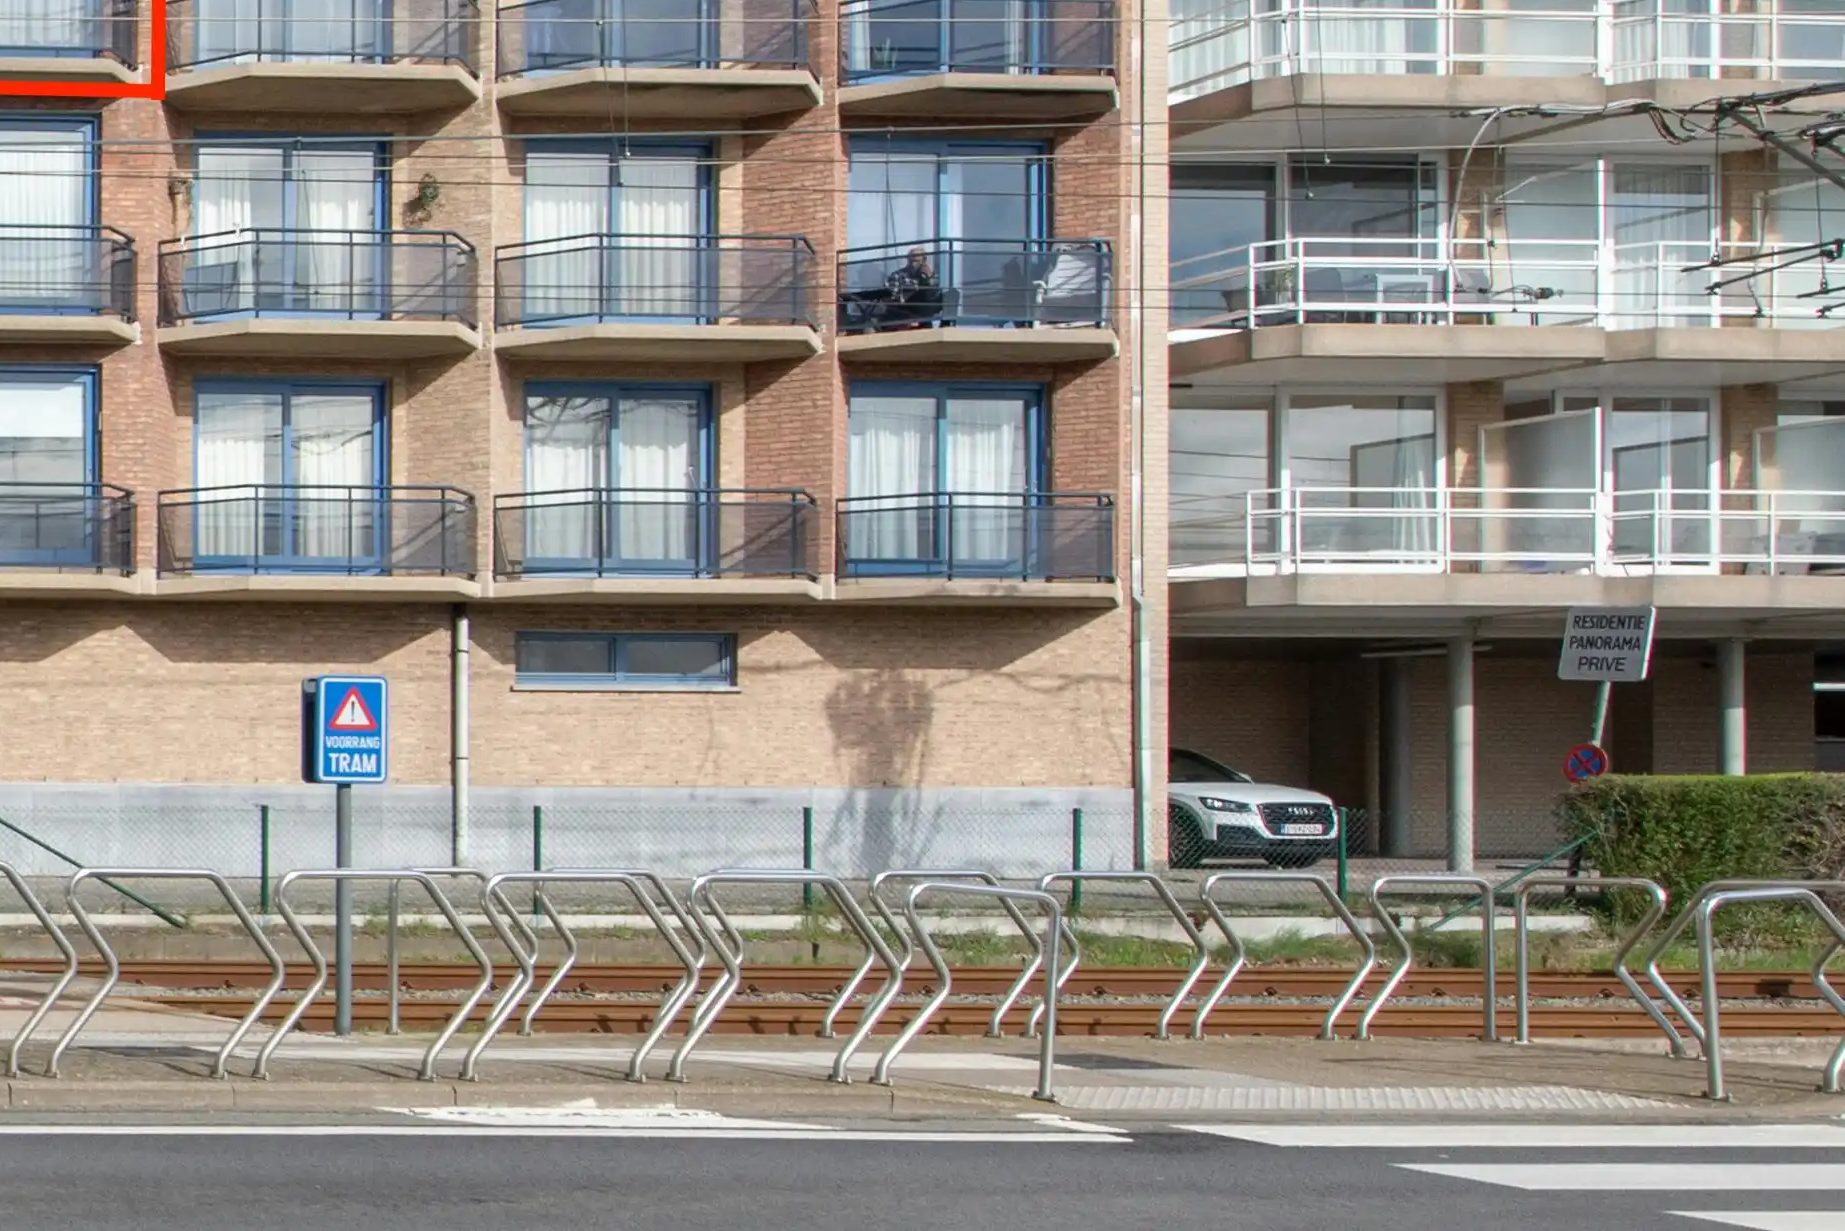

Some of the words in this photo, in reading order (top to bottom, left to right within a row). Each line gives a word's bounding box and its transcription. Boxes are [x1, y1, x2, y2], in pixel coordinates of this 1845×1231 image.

[1573, 615, 1646, 630] RESIDENTIE
[1569, 635, 1641, 651] PANORAMA
[1577, 656, 1627, 672] PRIVE
[325, 735, 380, 749] VOORRANG
[328, 752, 377, 773] TRAM
